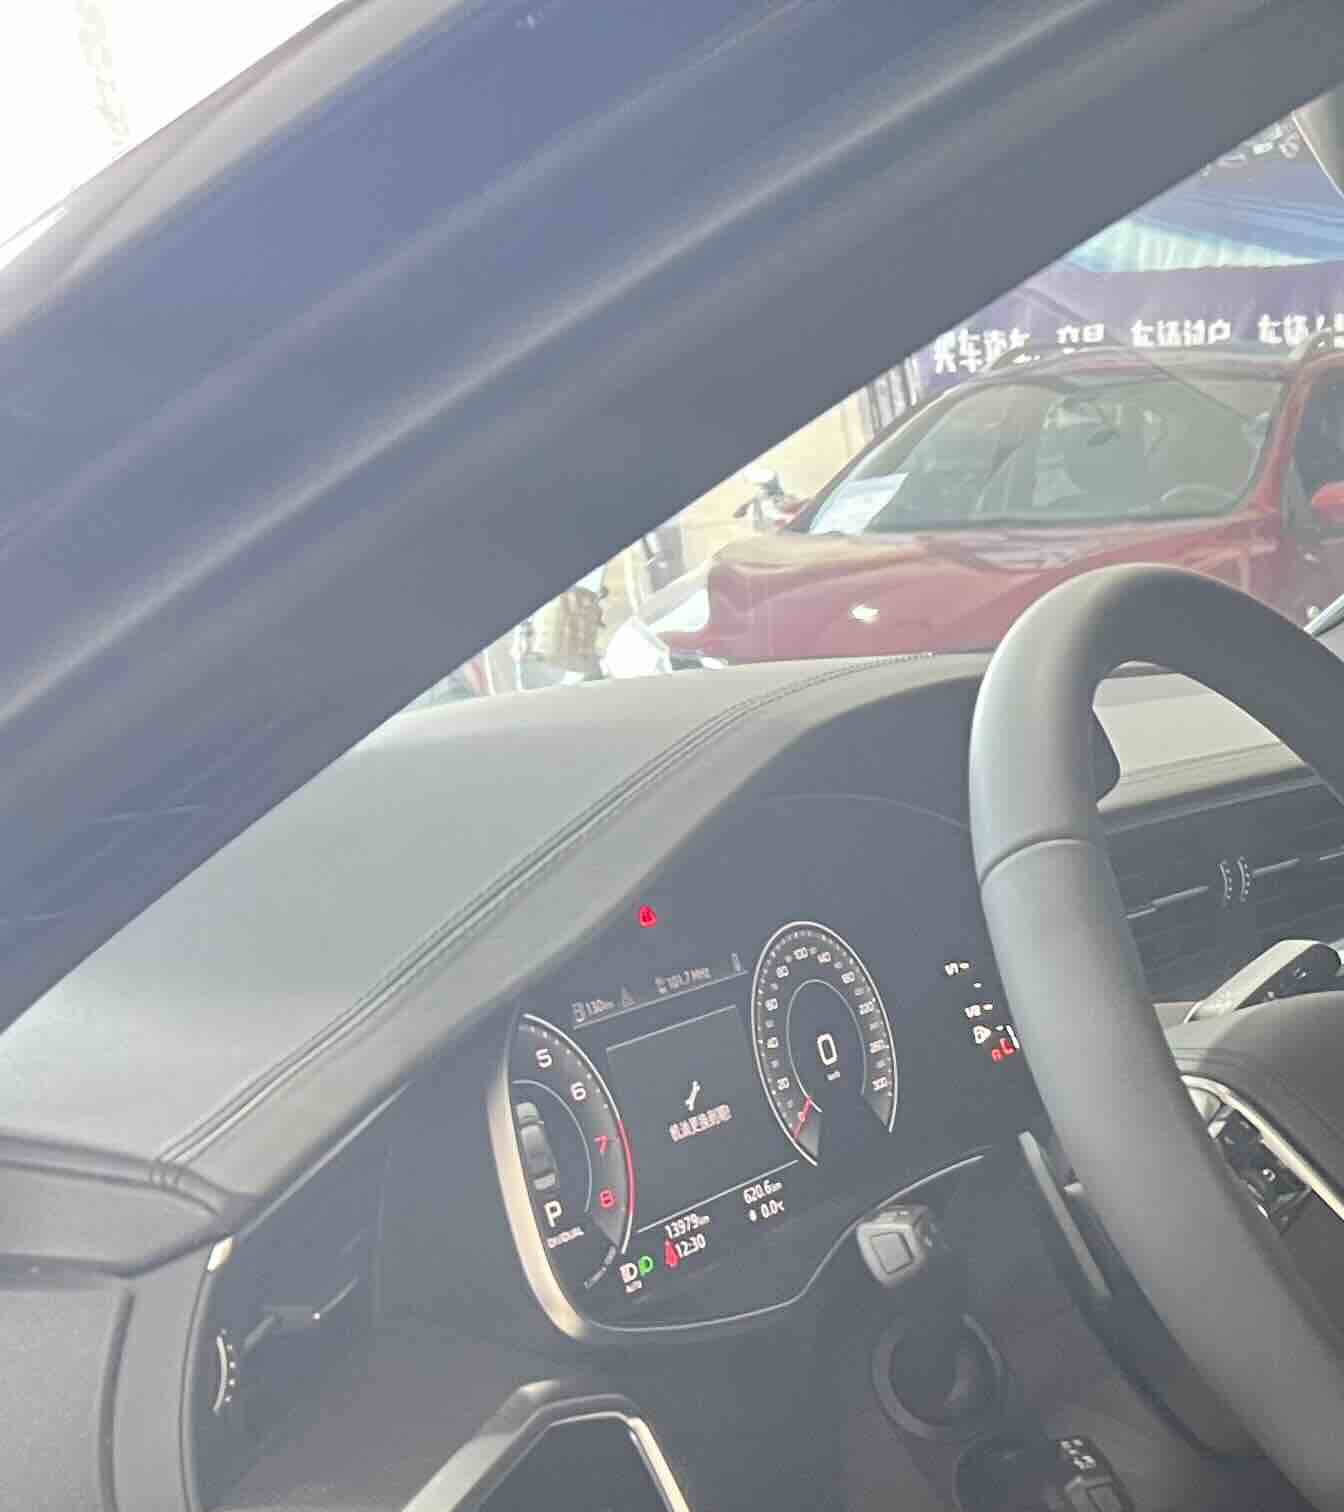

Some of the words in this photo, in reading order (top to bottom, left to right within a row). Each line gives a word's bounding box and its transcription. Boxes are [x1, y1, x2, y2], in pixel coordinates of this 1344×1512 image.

[536, 1049, 552, 1068] 5
[817, 1033, 837, 1065] 0
[570, 1082, 587, 1101] 6
[593, 1136, 609, 1157] 7
[599, 1190, 615, 1208] 8
[544, 1200, 562, 1227] P
[675, 1233, 706, 1258] 12:30
